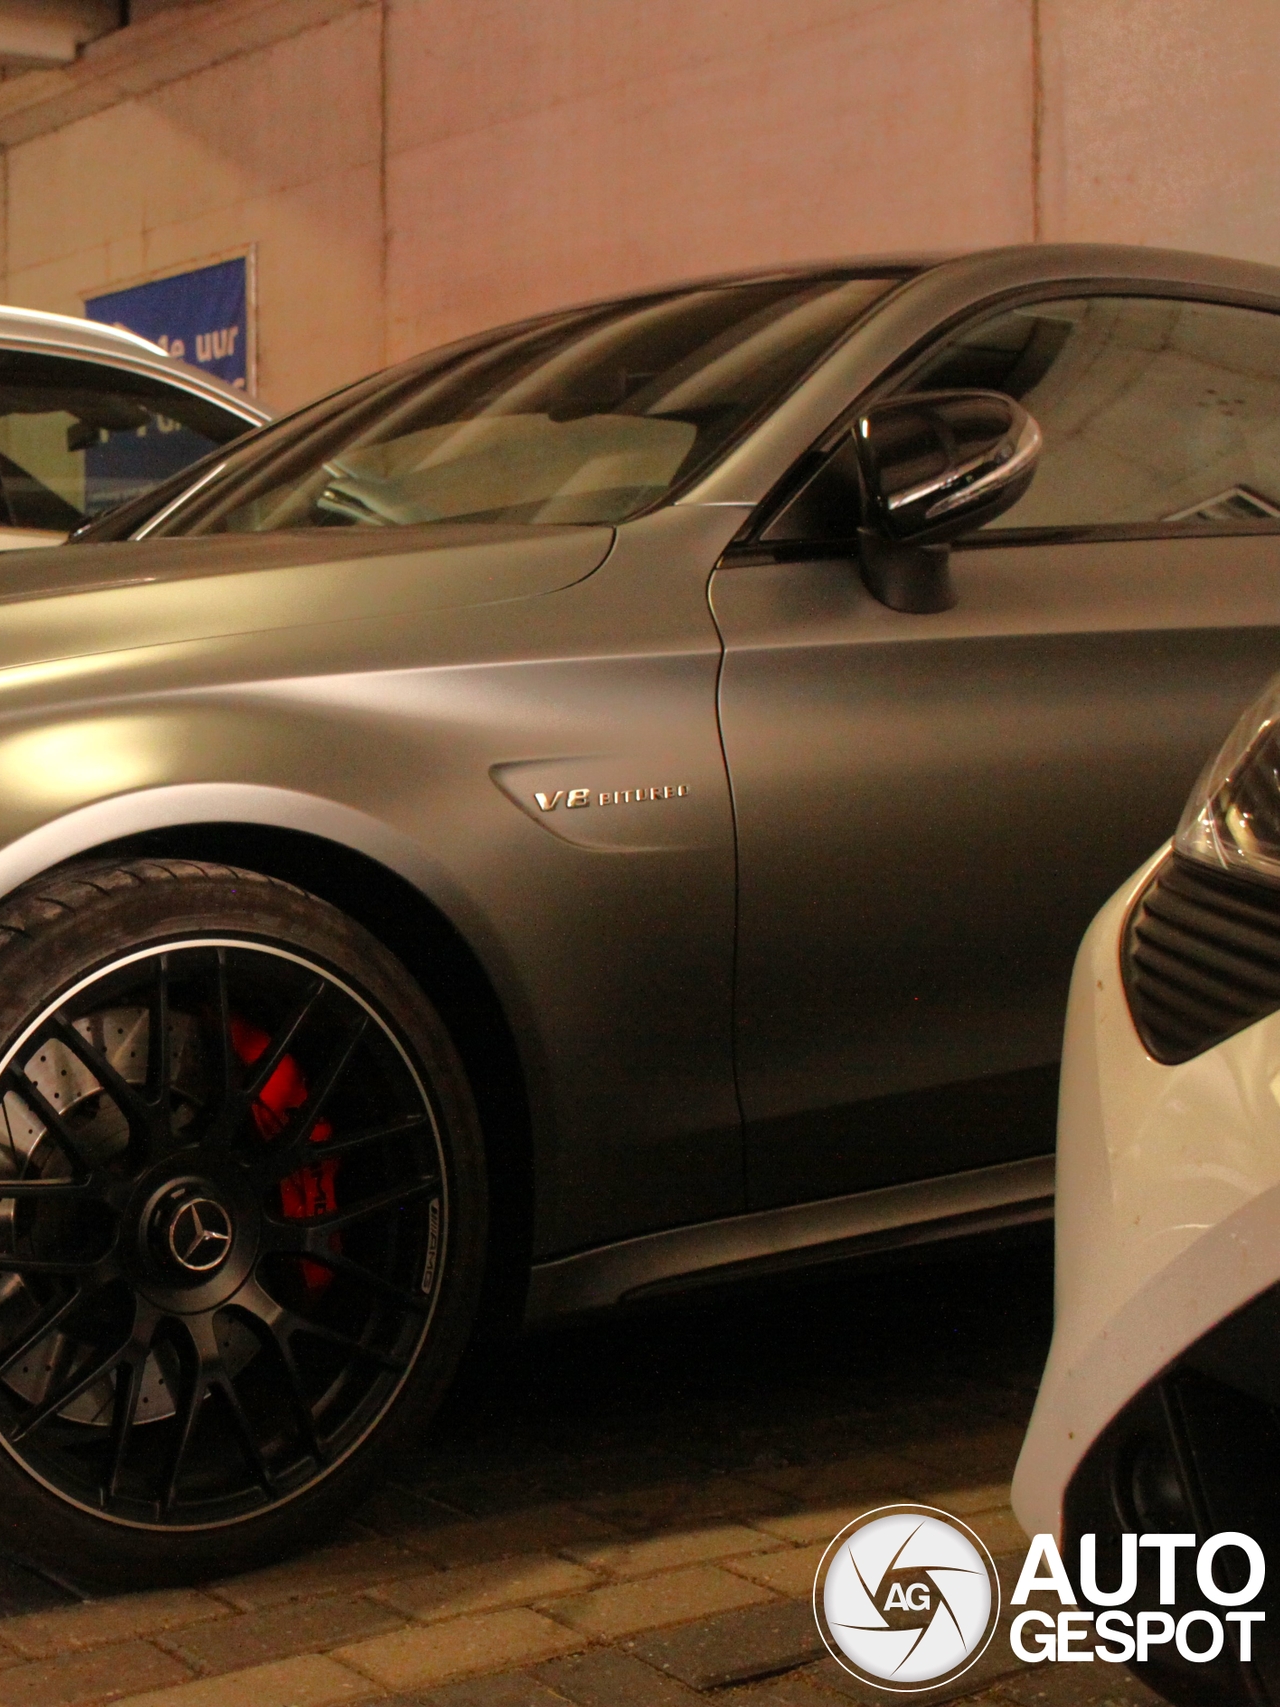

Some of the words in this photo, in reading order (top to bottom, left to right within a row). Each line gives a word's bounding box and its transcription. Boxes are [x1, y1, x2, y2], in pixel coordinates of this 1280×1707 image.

[195, 326, 239, 362] uur
[534, 788, 591, 812] V8
[598, 784, 690, 806] BITURBO
